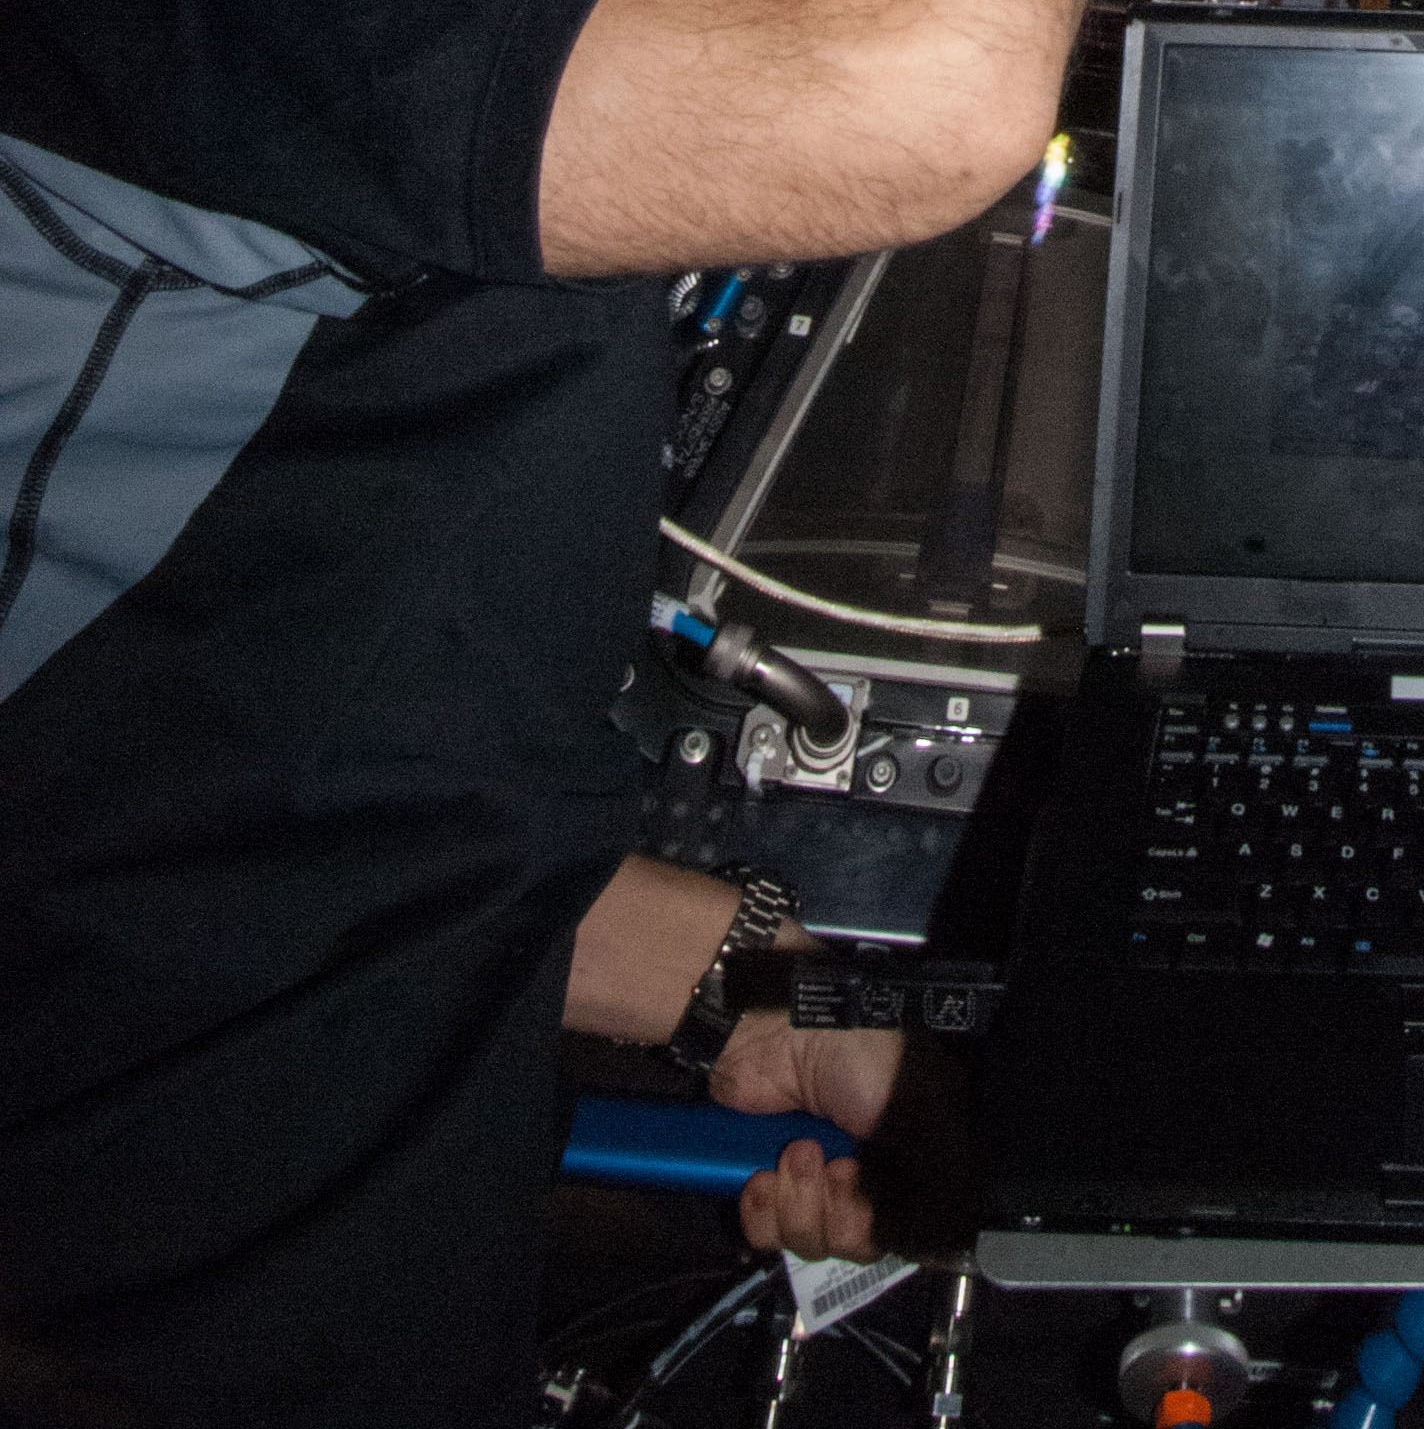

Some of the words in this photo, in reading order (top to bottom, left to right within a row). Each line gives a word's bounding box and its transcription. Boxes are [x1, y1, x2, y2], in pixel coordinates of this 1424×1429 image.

[796, 319, 804, 331] 7
[954, 702, 961, 714] 6
[1230, 802, 1245, 816] Q
[1281, 804, 1299, 817] W
[1330, 805, 1343, 819] E
[1381, 807, 1395, 821] R
[1238, 843, 1251, 856] A
[1290, 843, 1302, 857] S
[1341, 845, 1354, 859] D
[1393, 847, 1404, 860] F
[1259, 884, 1272, 898] Z
[1312, 886, 1326, 899] X
[1366, 888, 1379, 902] C
